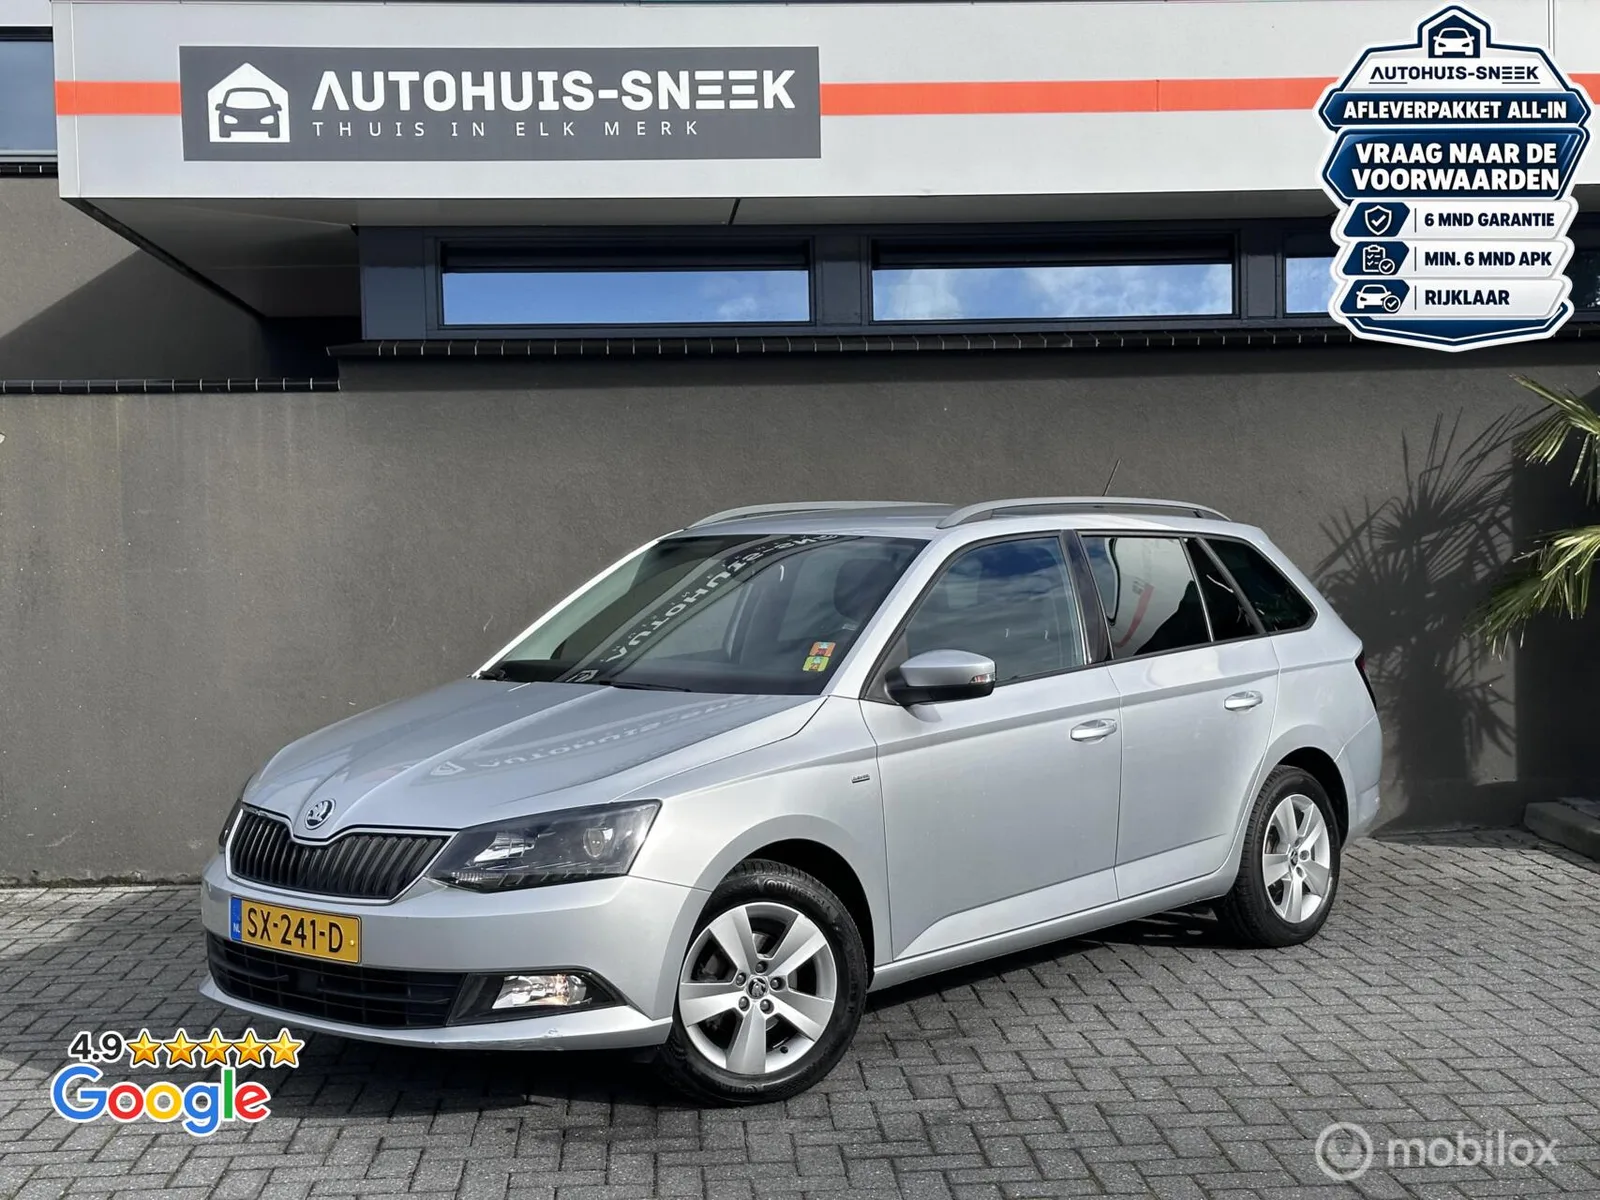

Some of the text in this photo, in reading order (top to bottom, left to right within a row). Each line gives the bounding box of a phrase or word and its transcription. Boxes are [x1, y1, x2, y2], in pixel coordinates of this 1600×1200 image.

[312, 70, 795, 112] AUTOHUIS-SNEEK
[313, 120, 698, 138] THUIS IN ELK MERK
[232, 907, 343, 953] NL SX-241-D
